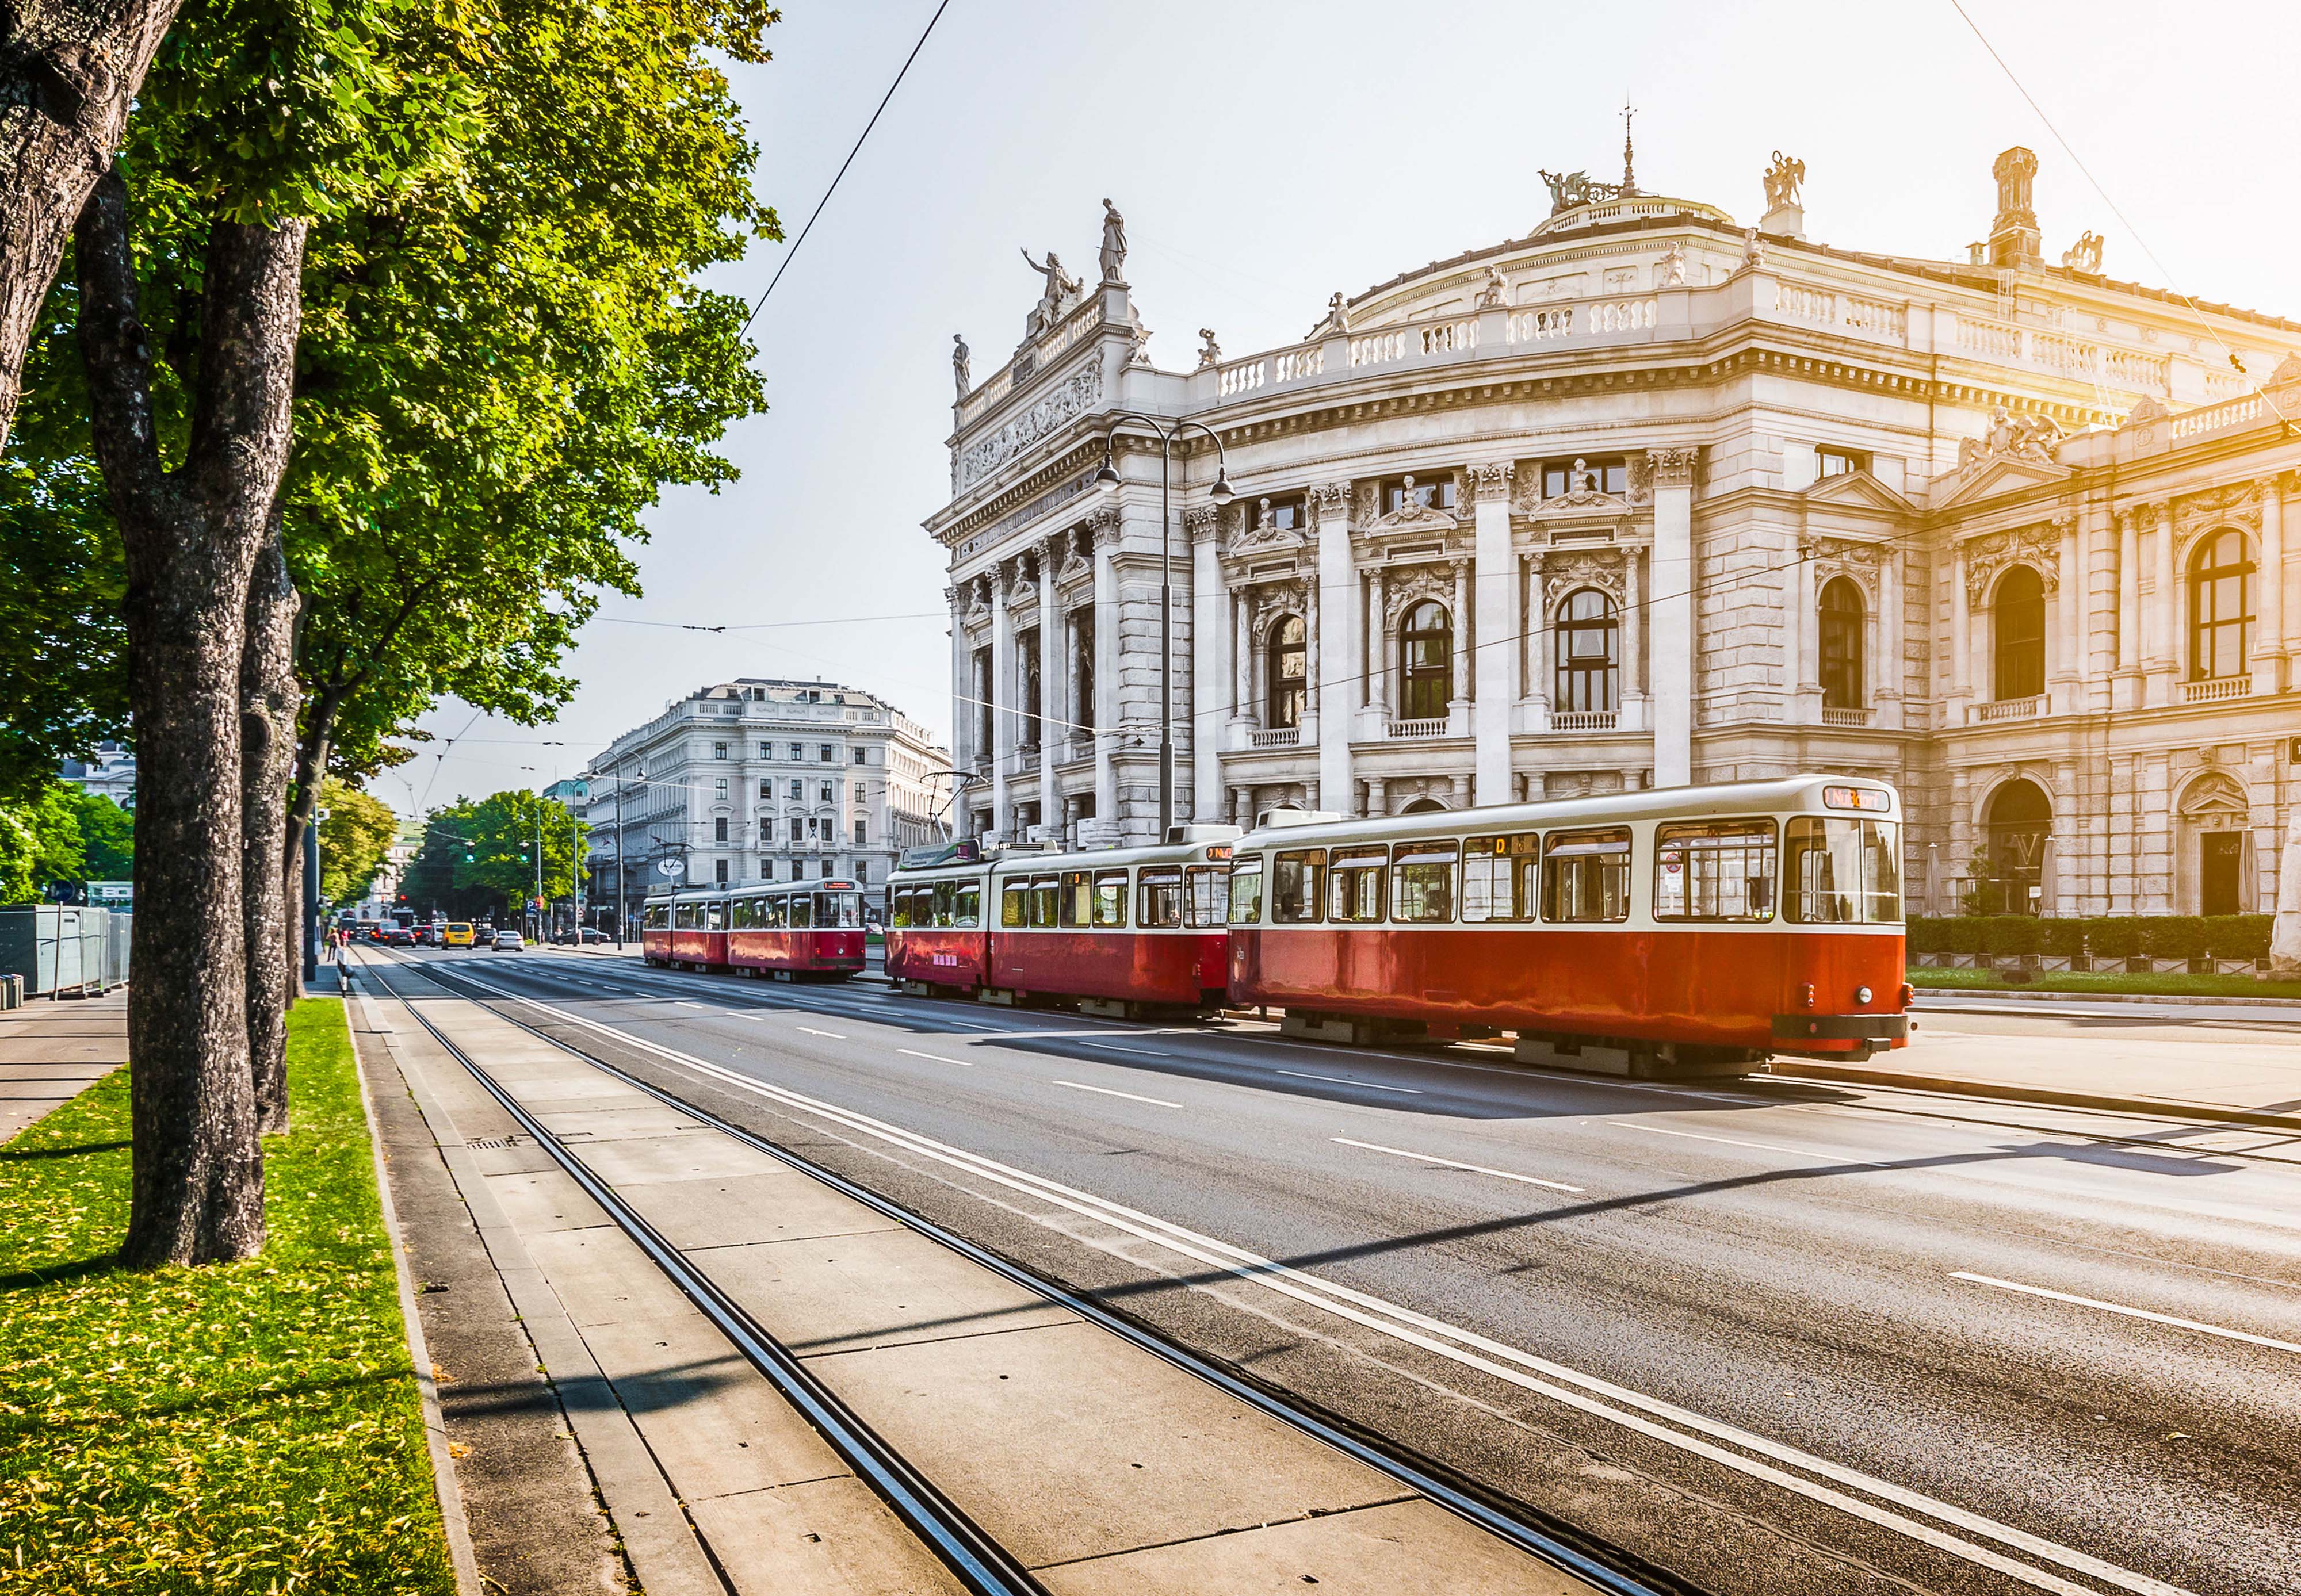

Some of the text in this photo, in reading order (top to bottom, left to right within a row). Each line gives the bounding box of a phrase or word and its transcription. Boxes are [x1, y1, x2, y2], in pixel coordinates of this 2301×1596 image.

[1832, 788, 1879, 809] Nußdorf
[1496, 839, 1505, 854] D
[2014, 833, 2040, 864] V
[527, 901, 534, 909] P
